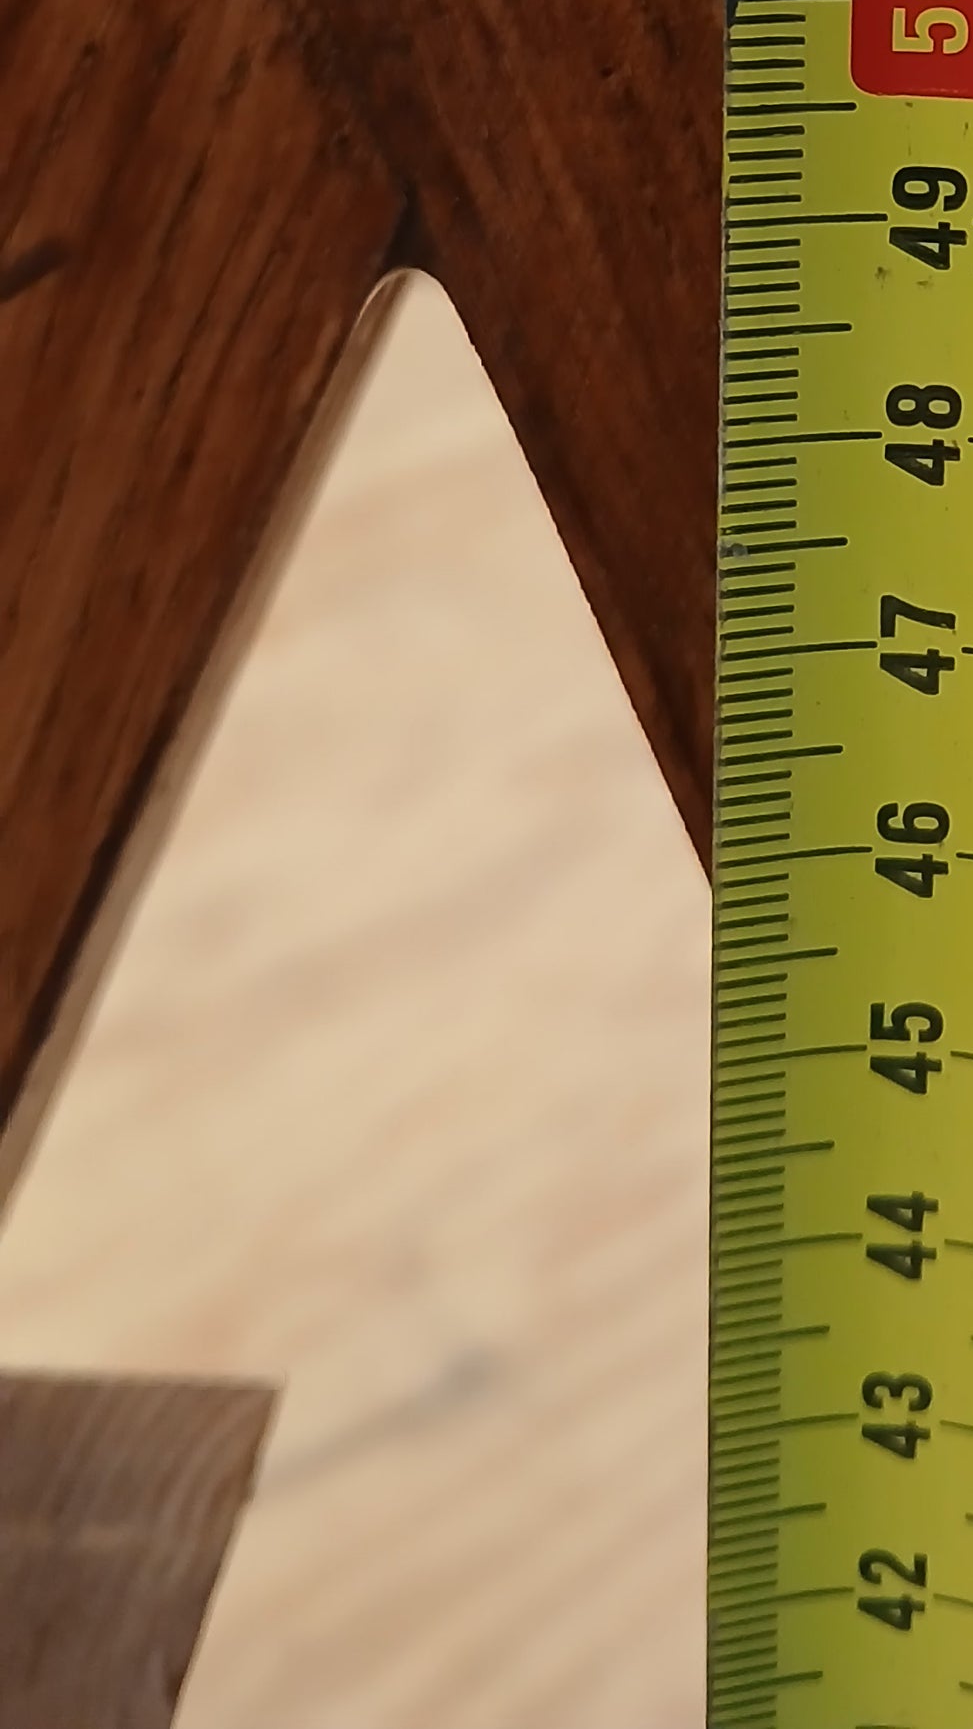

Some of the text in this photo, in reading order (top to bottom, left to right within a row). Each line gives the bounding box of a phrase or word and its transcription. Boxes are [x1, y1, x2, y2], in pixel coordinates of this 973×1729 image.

[889, 165, 968, 271] 49
[885, 383, 962, 487] 48
[880, 594, 956, 696] 47
[875, 801, 950, 899] 46
[869, 1002, 944, 1095] 45
[866, 1190, 939, 1281] 44
[861, 1371, 933, 1460] 43
[857, 1548, 928, 1632] 42
